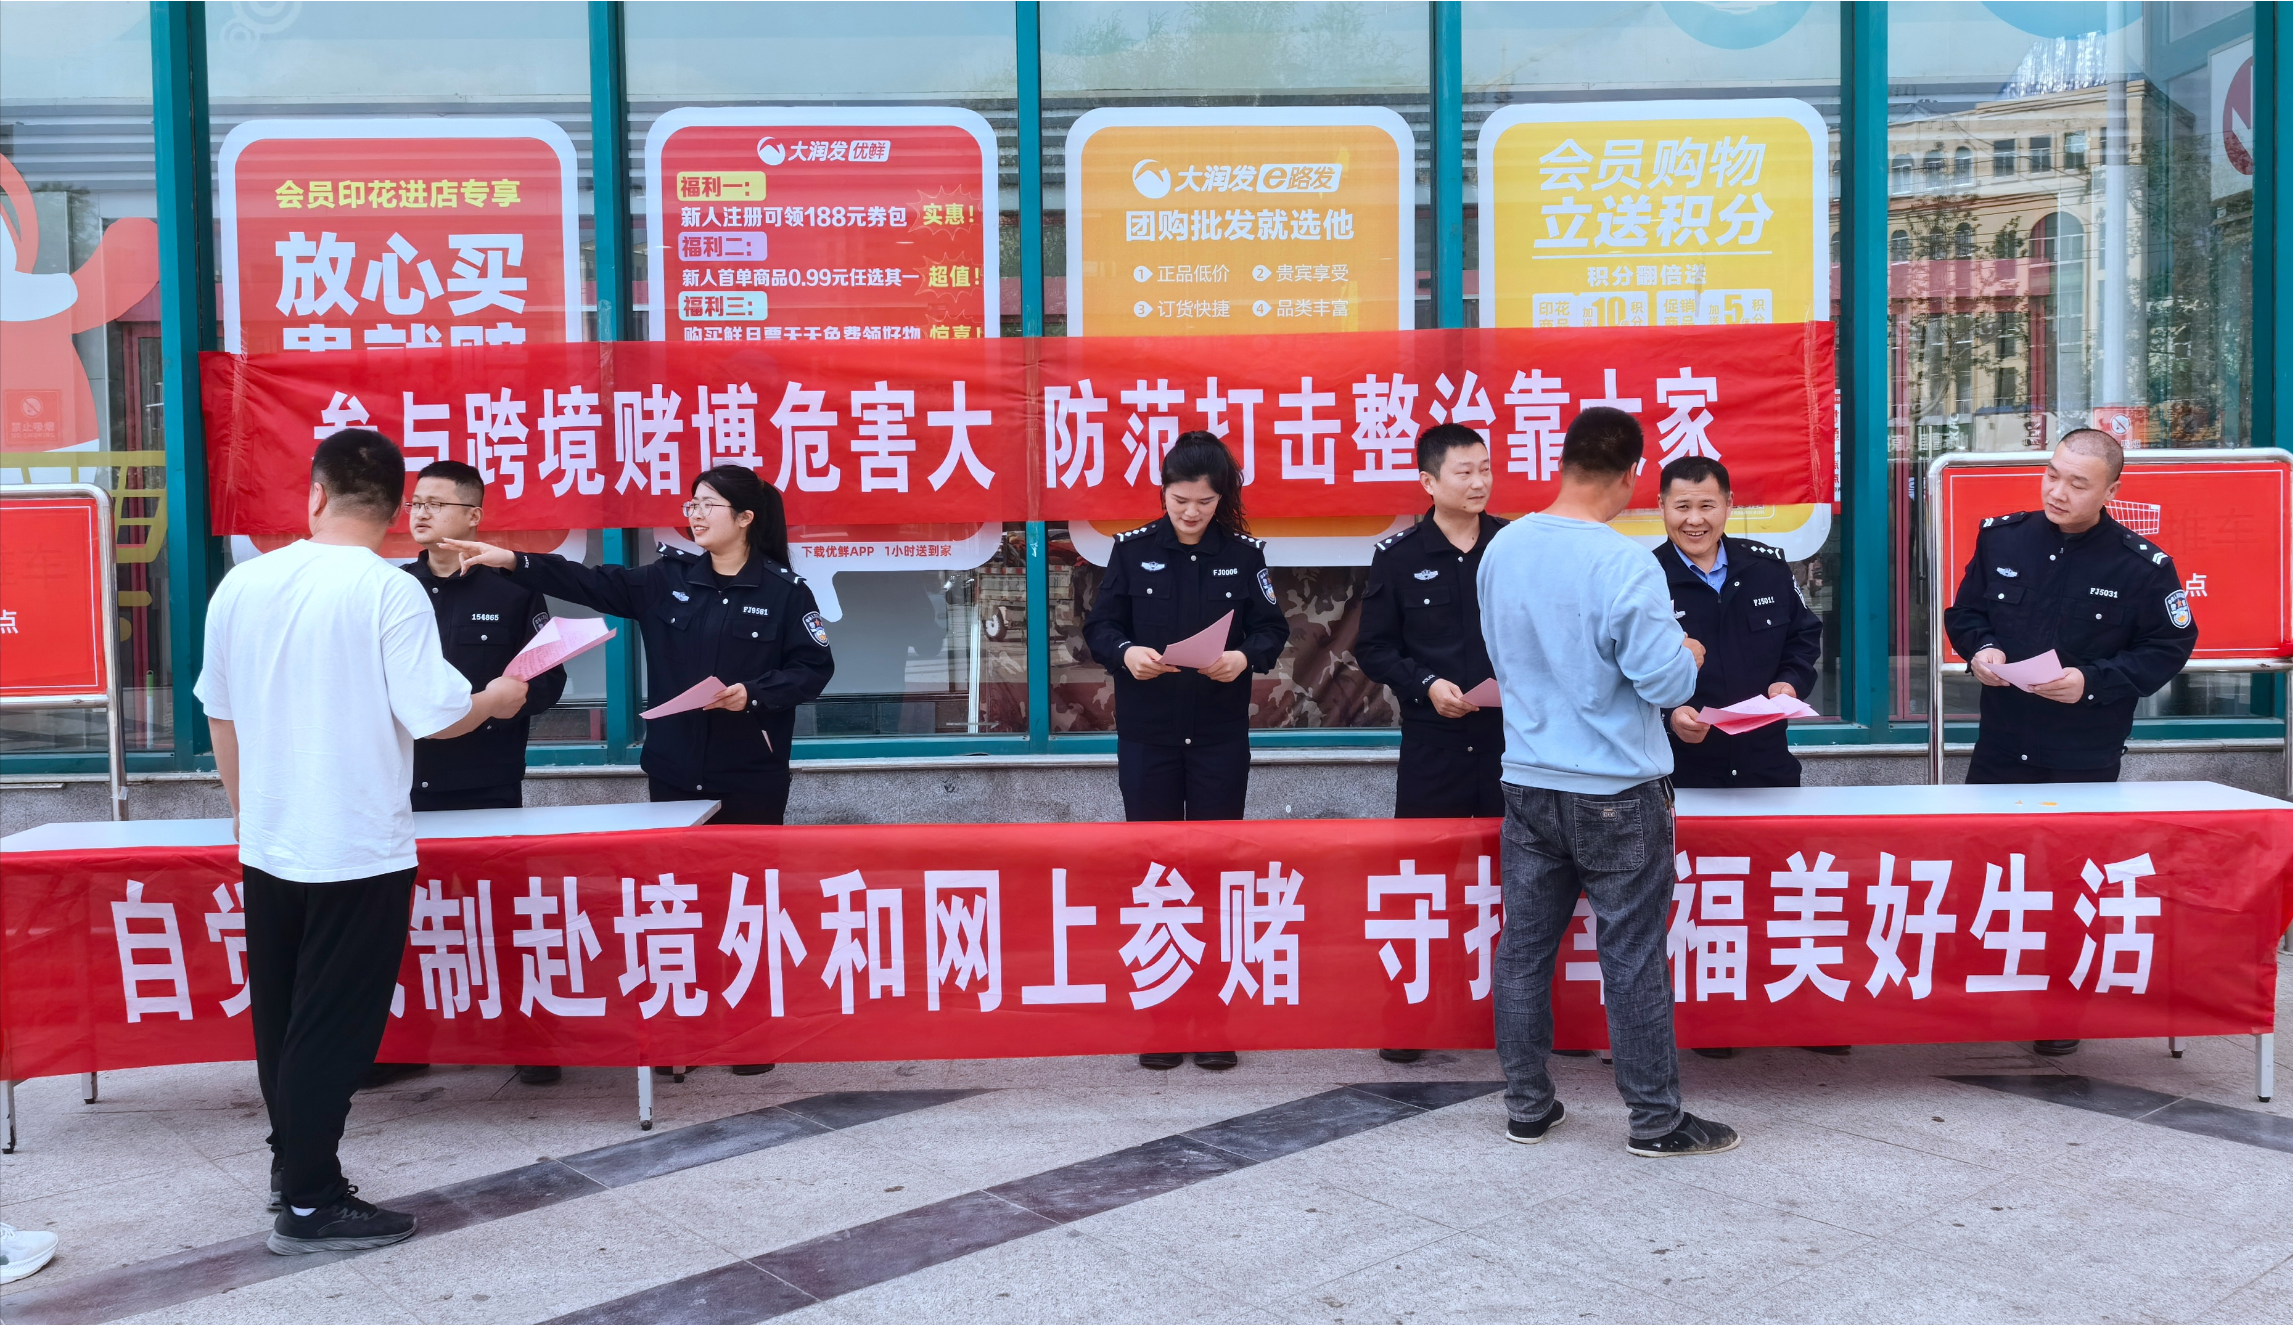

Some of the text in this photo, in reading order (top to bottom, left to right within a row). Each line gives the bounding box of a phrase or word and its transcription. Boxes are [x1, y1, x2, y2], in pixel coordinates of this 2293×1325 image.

[788, 140, 891, 162] 大润发优鲜
[1538, 136, 1767, 192] 会员购物
[680, 176, 750, 198] 福利一：
[1174, 163, 1337, 192] 大润发e路发
[275, 179, 521, 209] 会员印花进店专享
[681, 206, 908, 228] 新人注册可领188元券包
[1125, 208, 1354, 242] 团购批发就选他
[1533, 192, 1774, 249] 立送积分
[681, 236, 752, 258] 福利二：
[275, 231, 528, 317] 放心买
[682, 267, 920, 288] 新人首单商品0.99元任选其一
[1157, 264, 1230, 283] 正品低价
[1276, 264, 1349, 283] 贵宾享受
[1587, 264, 1707, 288] 积分翻倍送
[682, 295, 754, 317] 福利三：
[1157, 299, 1230, 318] 订货快捷
[1276, 299, 1349, 318] 品类丰富
[1539, 301, 1571, 316] 印花
[1592, 296, 1626, 327] 10
[1663, 298, 1696, 314] 促销
[1724, 294, 1744, 325] 5
[801, 544, 952, 558] 下载优鲜APP 1小时送到家
[2089, 587, 2119, 599] FJ5031
[2184, 573, 2208, 599] 点
[112, 861, 1305, 1023] 自制赴境外和网上参赌
